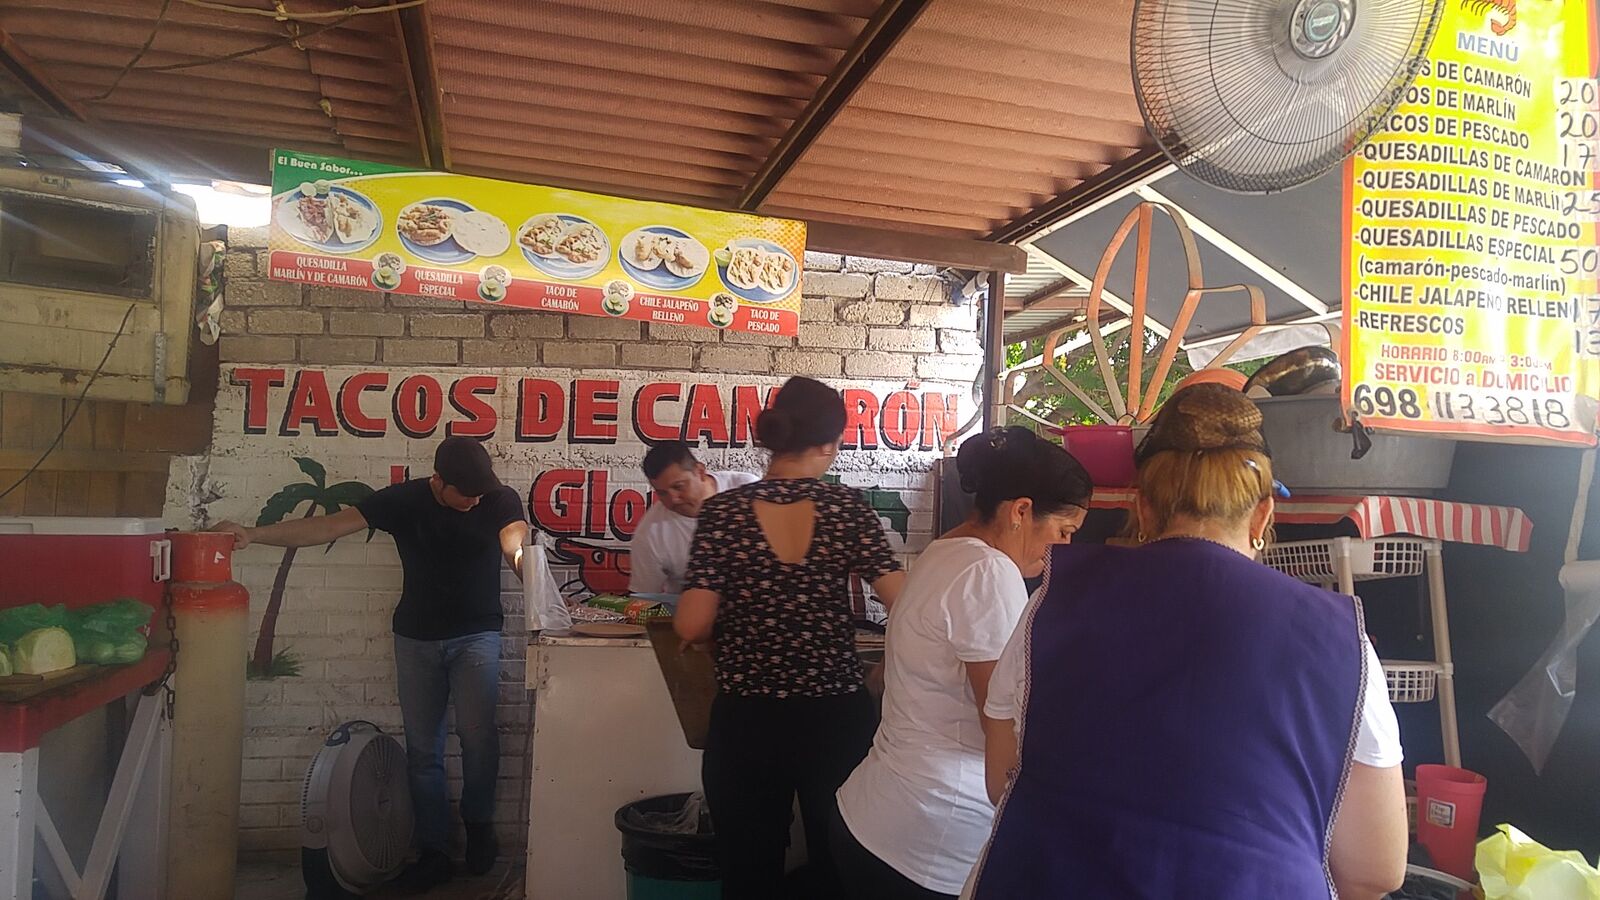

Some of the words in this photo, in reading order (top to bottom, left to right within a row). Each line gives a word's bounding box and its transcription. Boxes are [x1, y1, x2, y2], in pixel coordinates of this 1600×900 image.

[1437, 61, 1458, 80] DE
[1464, 66, 1532, 98] CAMARÓN
[1560, 80, 1594, 105] 20
[1436, 90, 1457, 108] DE
[1463, 92, 1516, 121] MARLÍN
[1435, 117, 1457, 136] DE
[1463, 120, 1530, 149] PESCADO
[1560, 111, 1597, 138] 20
[278, 156, 288, 165] El
[290, 158, 317, 169] Buen
[1494, 156, 1511, 173] DE
[1563, 143, 1596, 169] 17
[1493, 181, 1510, 200] DE
[1491, 209, 1509, 229] DE
[1513, 213, 1581, 240] PESCADO
[1488, 237, 1556, 264] ESPECIAL
[1560, 249, 1599, 274] 50
[296, 257, 348, 272] QUESADILLA
[273, 266, 306, 280] MARLÍN
[307, 270, 313, 280] Y
[314, 271, 327, 283] DE
[327, 273, 368, 288] CAMARÓN
[414, 270, 463, 285] QUESADILLA
[419, 282, 456, 297] ESPECIAL
[544, 285, 565, 297] TACO
[566, 287, 578, 298] DE
[541, 295, 579, 311] CAMARÓN
[639, 296, 661, 309] CHILE
[662, 298, 699, 312] JALAPEÑO
[1507, 297, 1573, 319] RELLEN
[652, 309, 684, 323] RELLENO
[750, 309, 769, 321] TACO
[770, 311, 780, 321] DE
[747, 320, 780, 333] PESCADO
[1381, 344, 1447, 362] HORARIO
[1374, 362, 1459, 385] SERVICIO
[1466, 373, 1475, 386] a
[230, 367, 498, 442] TACOS
[515, 377, 620, 445] DE
[631, 380, 959, 452] CAMRÓN
[1354, 383, 1421, 419] 698
